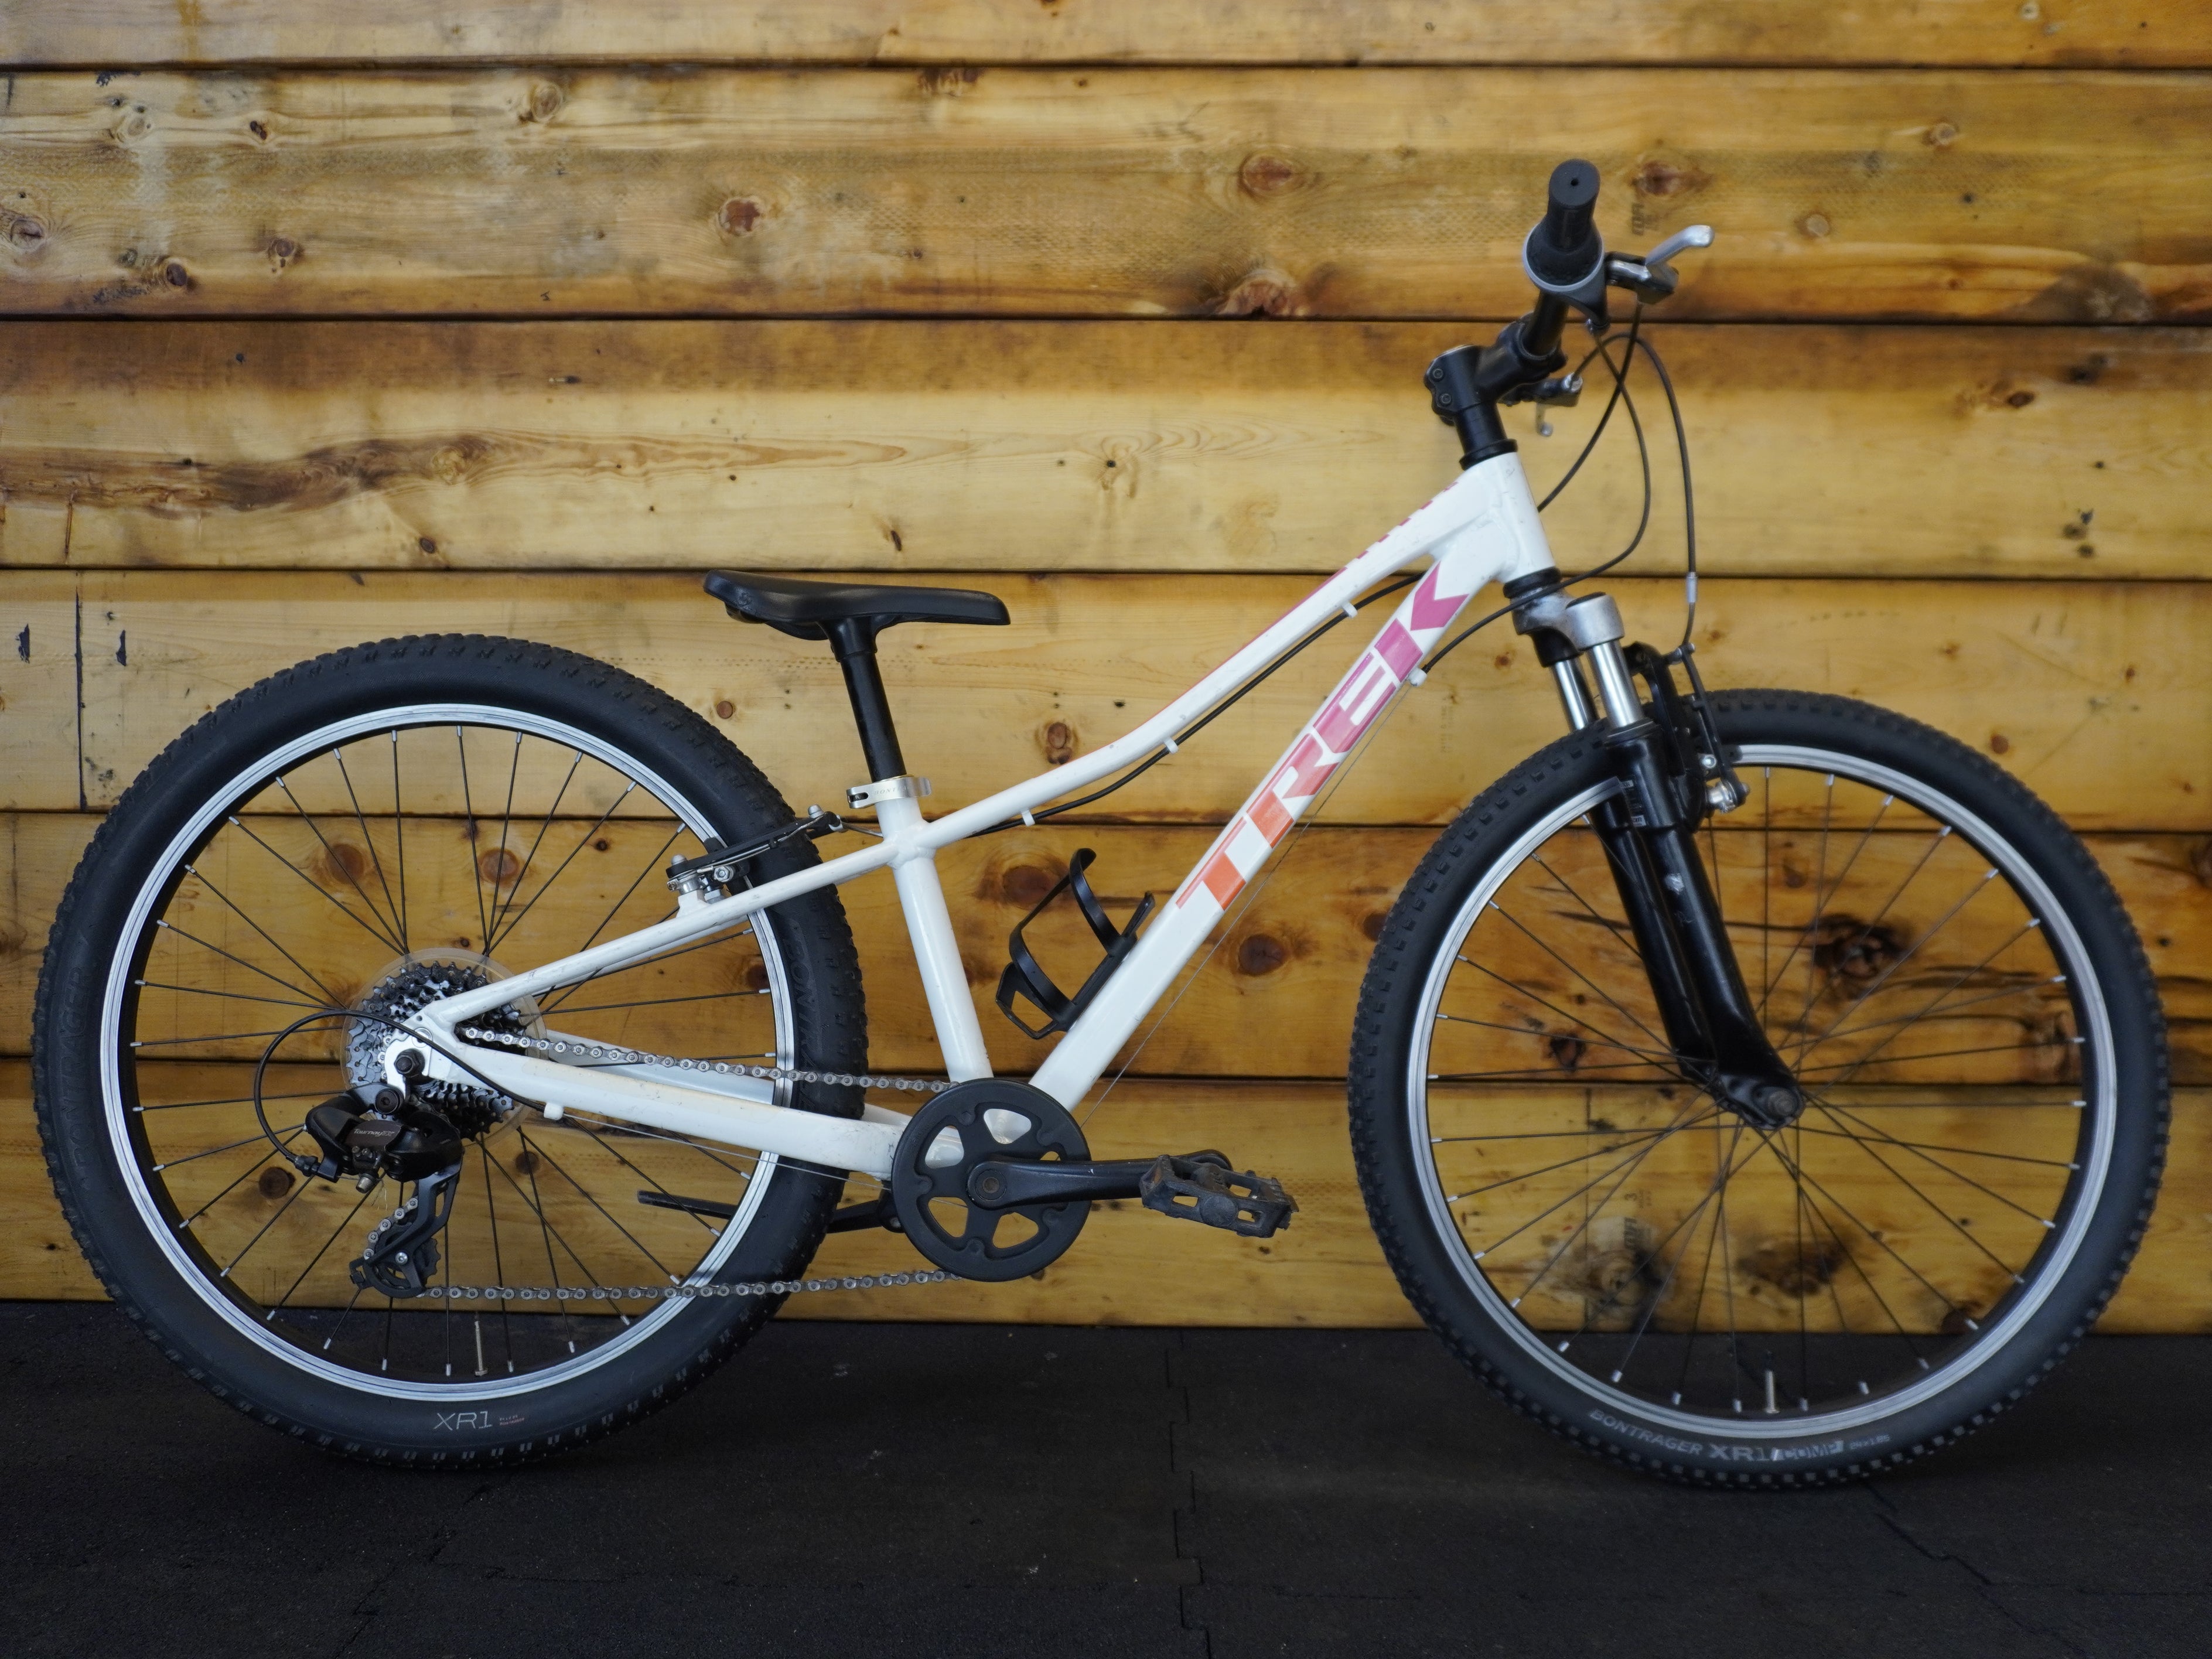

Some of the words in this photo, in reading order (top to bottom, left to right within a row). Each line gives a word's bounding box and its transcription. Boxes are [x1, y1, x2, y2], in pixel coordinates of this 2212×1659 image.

[1175, 561, 1469, 911] TREK
[433, 1410, 493, 1431] XR1
[1589, 1409, 1703, 1455] BONTRAGER
[1709, 1443, 1770, 1462] XR1
